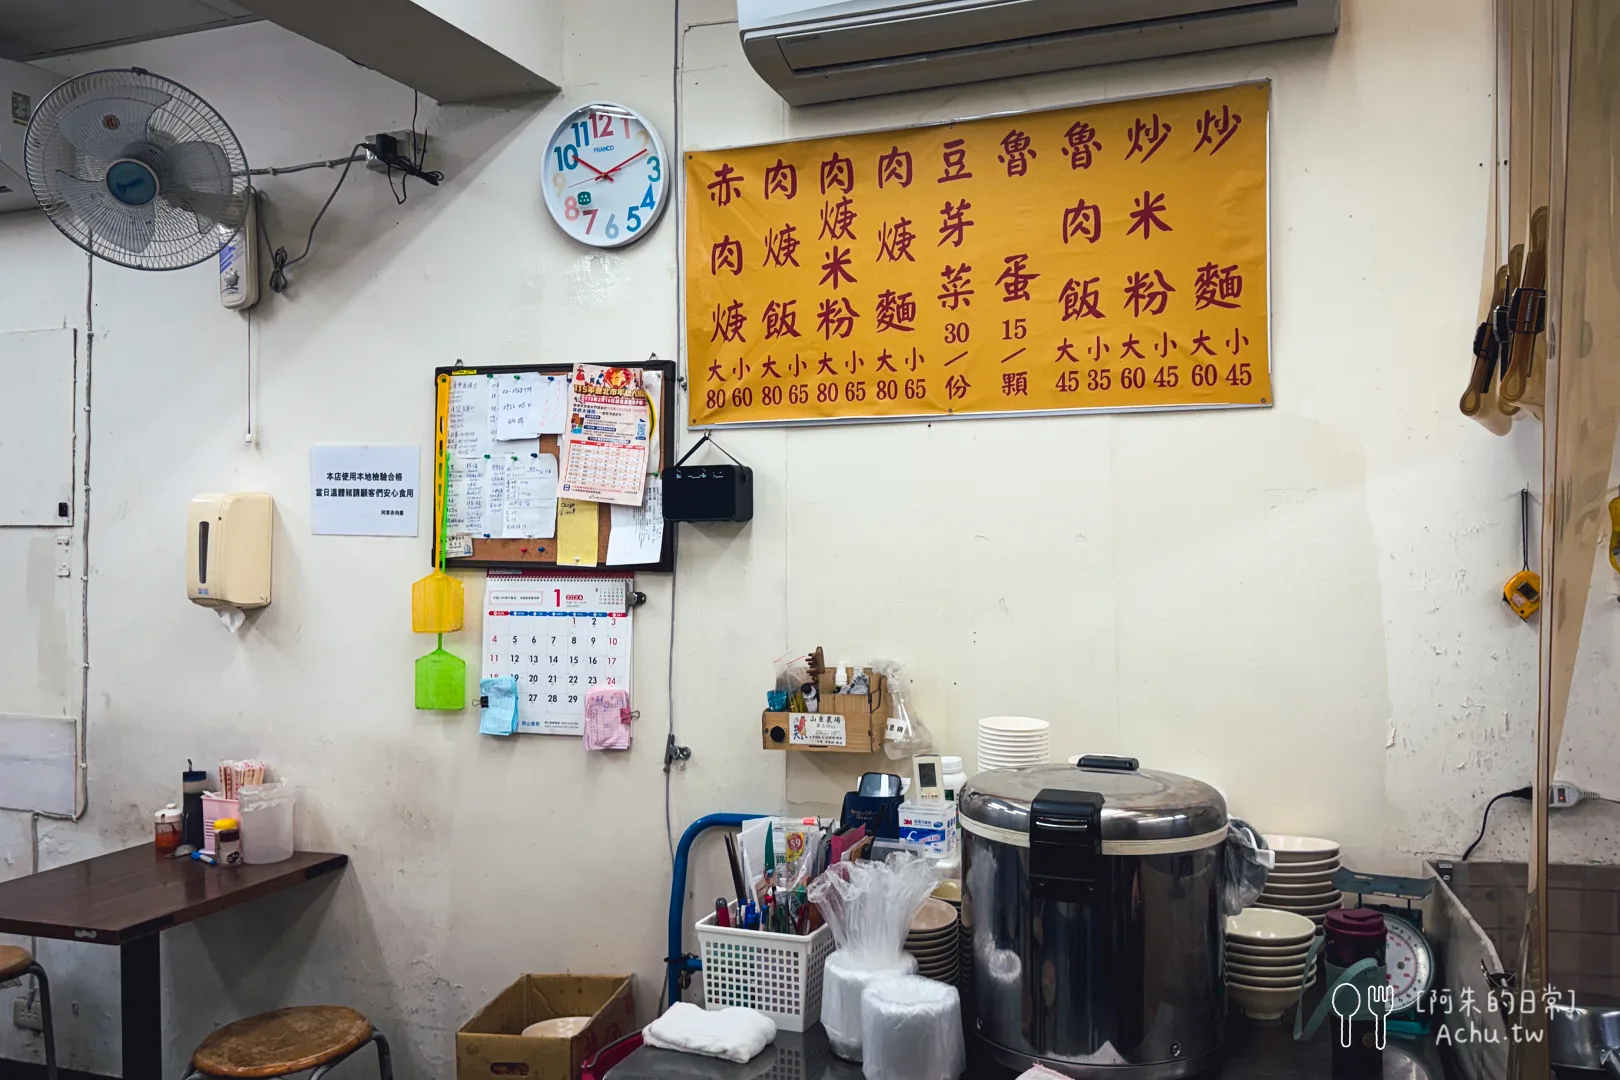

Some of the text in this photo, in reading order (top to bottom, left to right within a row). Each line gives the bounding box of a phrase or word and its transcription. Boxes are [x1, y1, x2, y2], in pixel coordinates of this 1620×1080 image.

[571, 120, 590, 147] 11
[588, 112, 614, 138] 12
[554, 144, 578, 172] 10
[594, 144, 614, 153] FRANCO
[646, 156, 660, 182] 3
[553, 172, 566, 198] 9
[640, 183, 656, 210] 4
[564, 196, 579, 221] 8
[626, 205, 641, 232] 5
[1124, 113, 1176, 317] 炒米粉
[582, 208, 598, 235] 7
[605, 213, 619, 240] 6
[938, 139, 974, 310] 豆芽菜
[1058, 121, 1106, 321] 魯肉飯
[945, 323, 969, 343] 30
[1003, 319, 1026, 339] 15
[1055, 336, 1109, 362] 大 小
[1120, 332, 1177, 358] 大 小
[1190, 328, 1249, 355] 大 小
[707, 358, 750, 381] 大 小
[761, 354, 807, 378] 大 小
[817, 351, 864, 375] 大 小
[876, 347, 924, 372] 大 小
[1056, 369, 1111, 392] 45 35
[1121, 366, 1178, 389] 60 45
[1192, 363, 1252, 386] 60 45
[707, 387, 752, 408] 80 60
[762, 384, 808, 405] 80 65
[817, 382, 865, 402] 80 65
[877, 379, 926, 400] 80 65
[326, 472, 403, 482] 本店使用本地檢驗合格
[554, 588, 560, 607] 1
[592, 618, 596, 626] 2
[612, 618, 616, 626] 3
[512, 636, 518, 644] 5
[532, 636, 536, 644] 6
[572, 636, 576, 644] 8
[590, 636, 596, 644] 9
[608, 638, 618, 646] 10
[510, 654, 520, 662] 12
[530, 656, 538, 664] 13
[550, 656, 558, 664] 14
[570, 656, 578, 664] 15
[588, 656, 598, 664] 16
[528, 674, 538, 682] 20
[548, 674, 556, 682] 21
[568, 676, 578, 684] 22
[588, 676, 598, 684] 23
[606, 676, 616, 684] 24
[528, 694, 578, 702] 27 28 29
[790, 839, 801, 848] 59
